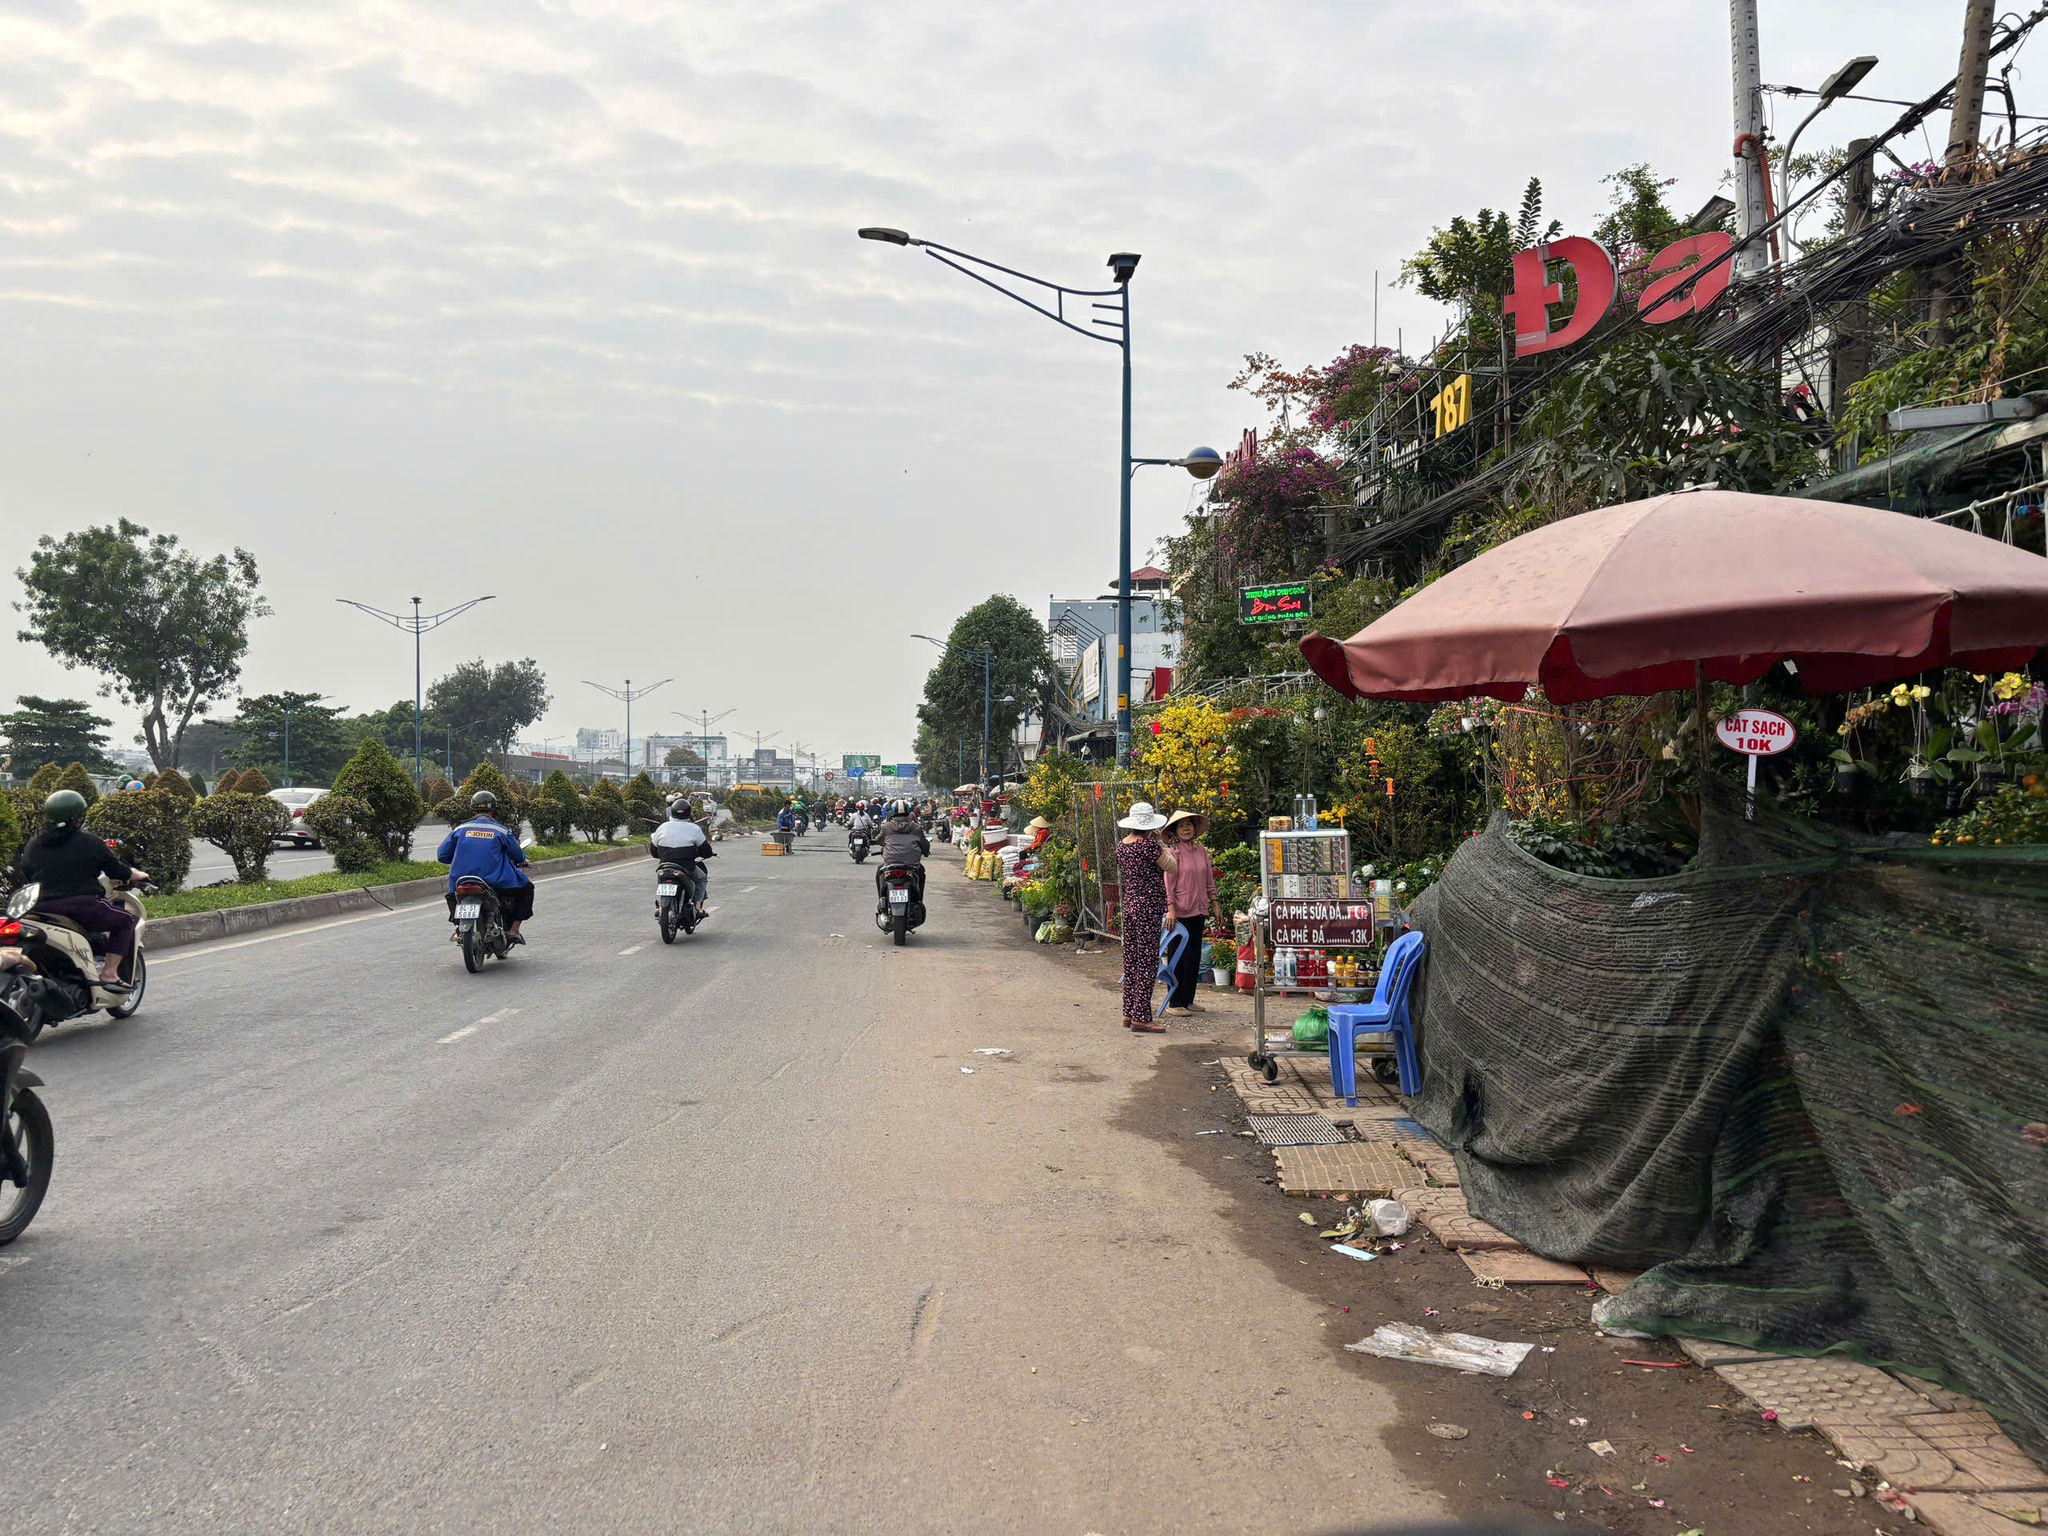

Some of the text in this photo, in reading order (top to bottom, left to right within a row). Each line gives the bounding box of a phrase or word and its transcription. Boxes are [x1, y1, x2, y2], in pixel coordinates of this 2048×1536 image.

[1430, 374, 1471, 439] 787
[1725, 715, 1786, 738] CÁT SẠCH
[1737, 737, 1772, 752] 10K
[1275, 901, 1289, 920] CÀ
[1290, 901, 1308, 920] PHÊ
[1309, 902, 1328, 920] SỮA
[1276, 924, 1289, 943] CÀ
[1290, 924, 1308, 943] PHÊ
